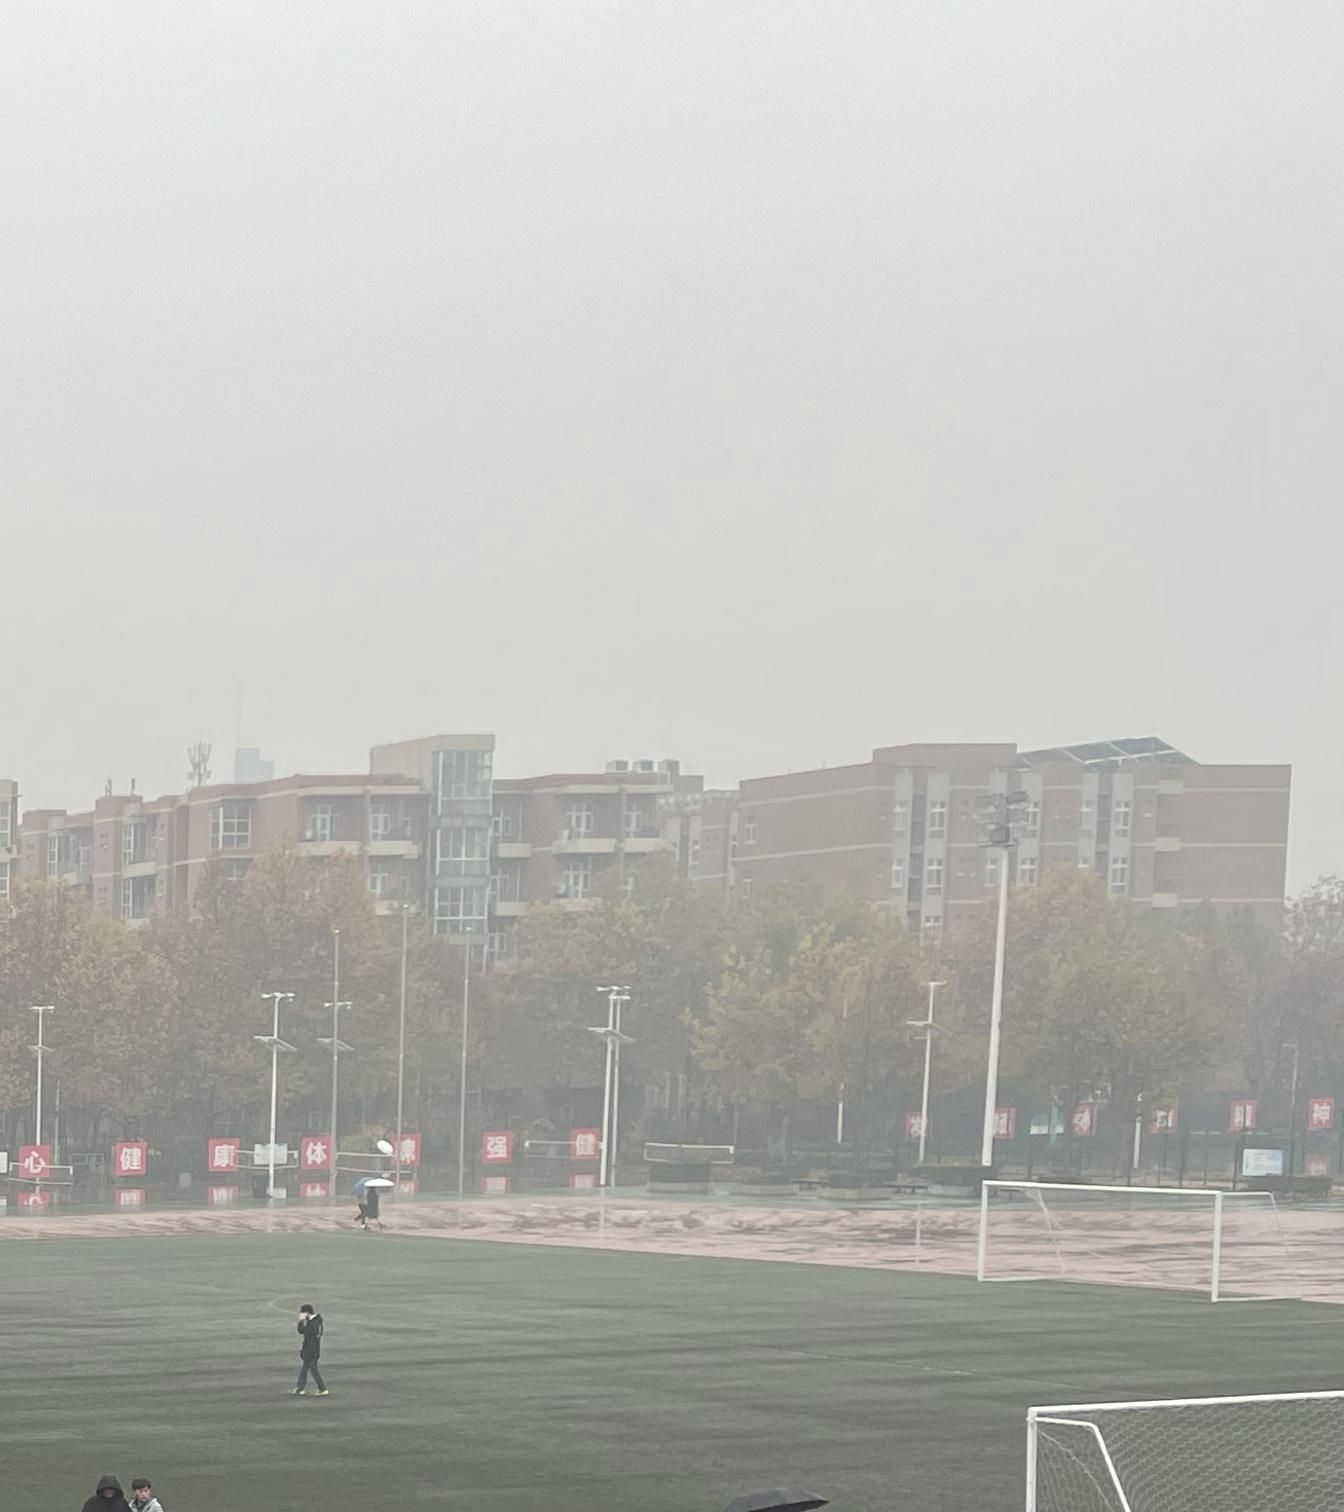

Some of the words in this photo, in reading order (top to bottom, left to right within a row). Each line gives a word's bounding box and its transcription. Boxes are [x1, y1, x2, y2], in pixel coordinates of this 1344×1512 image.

[23, 1151, 46, 1174] 心
[119, 1146, 142, 1171] 健
[213, 1143, 237, 1168] 康
[307, 1141, 328, 1166] 体
